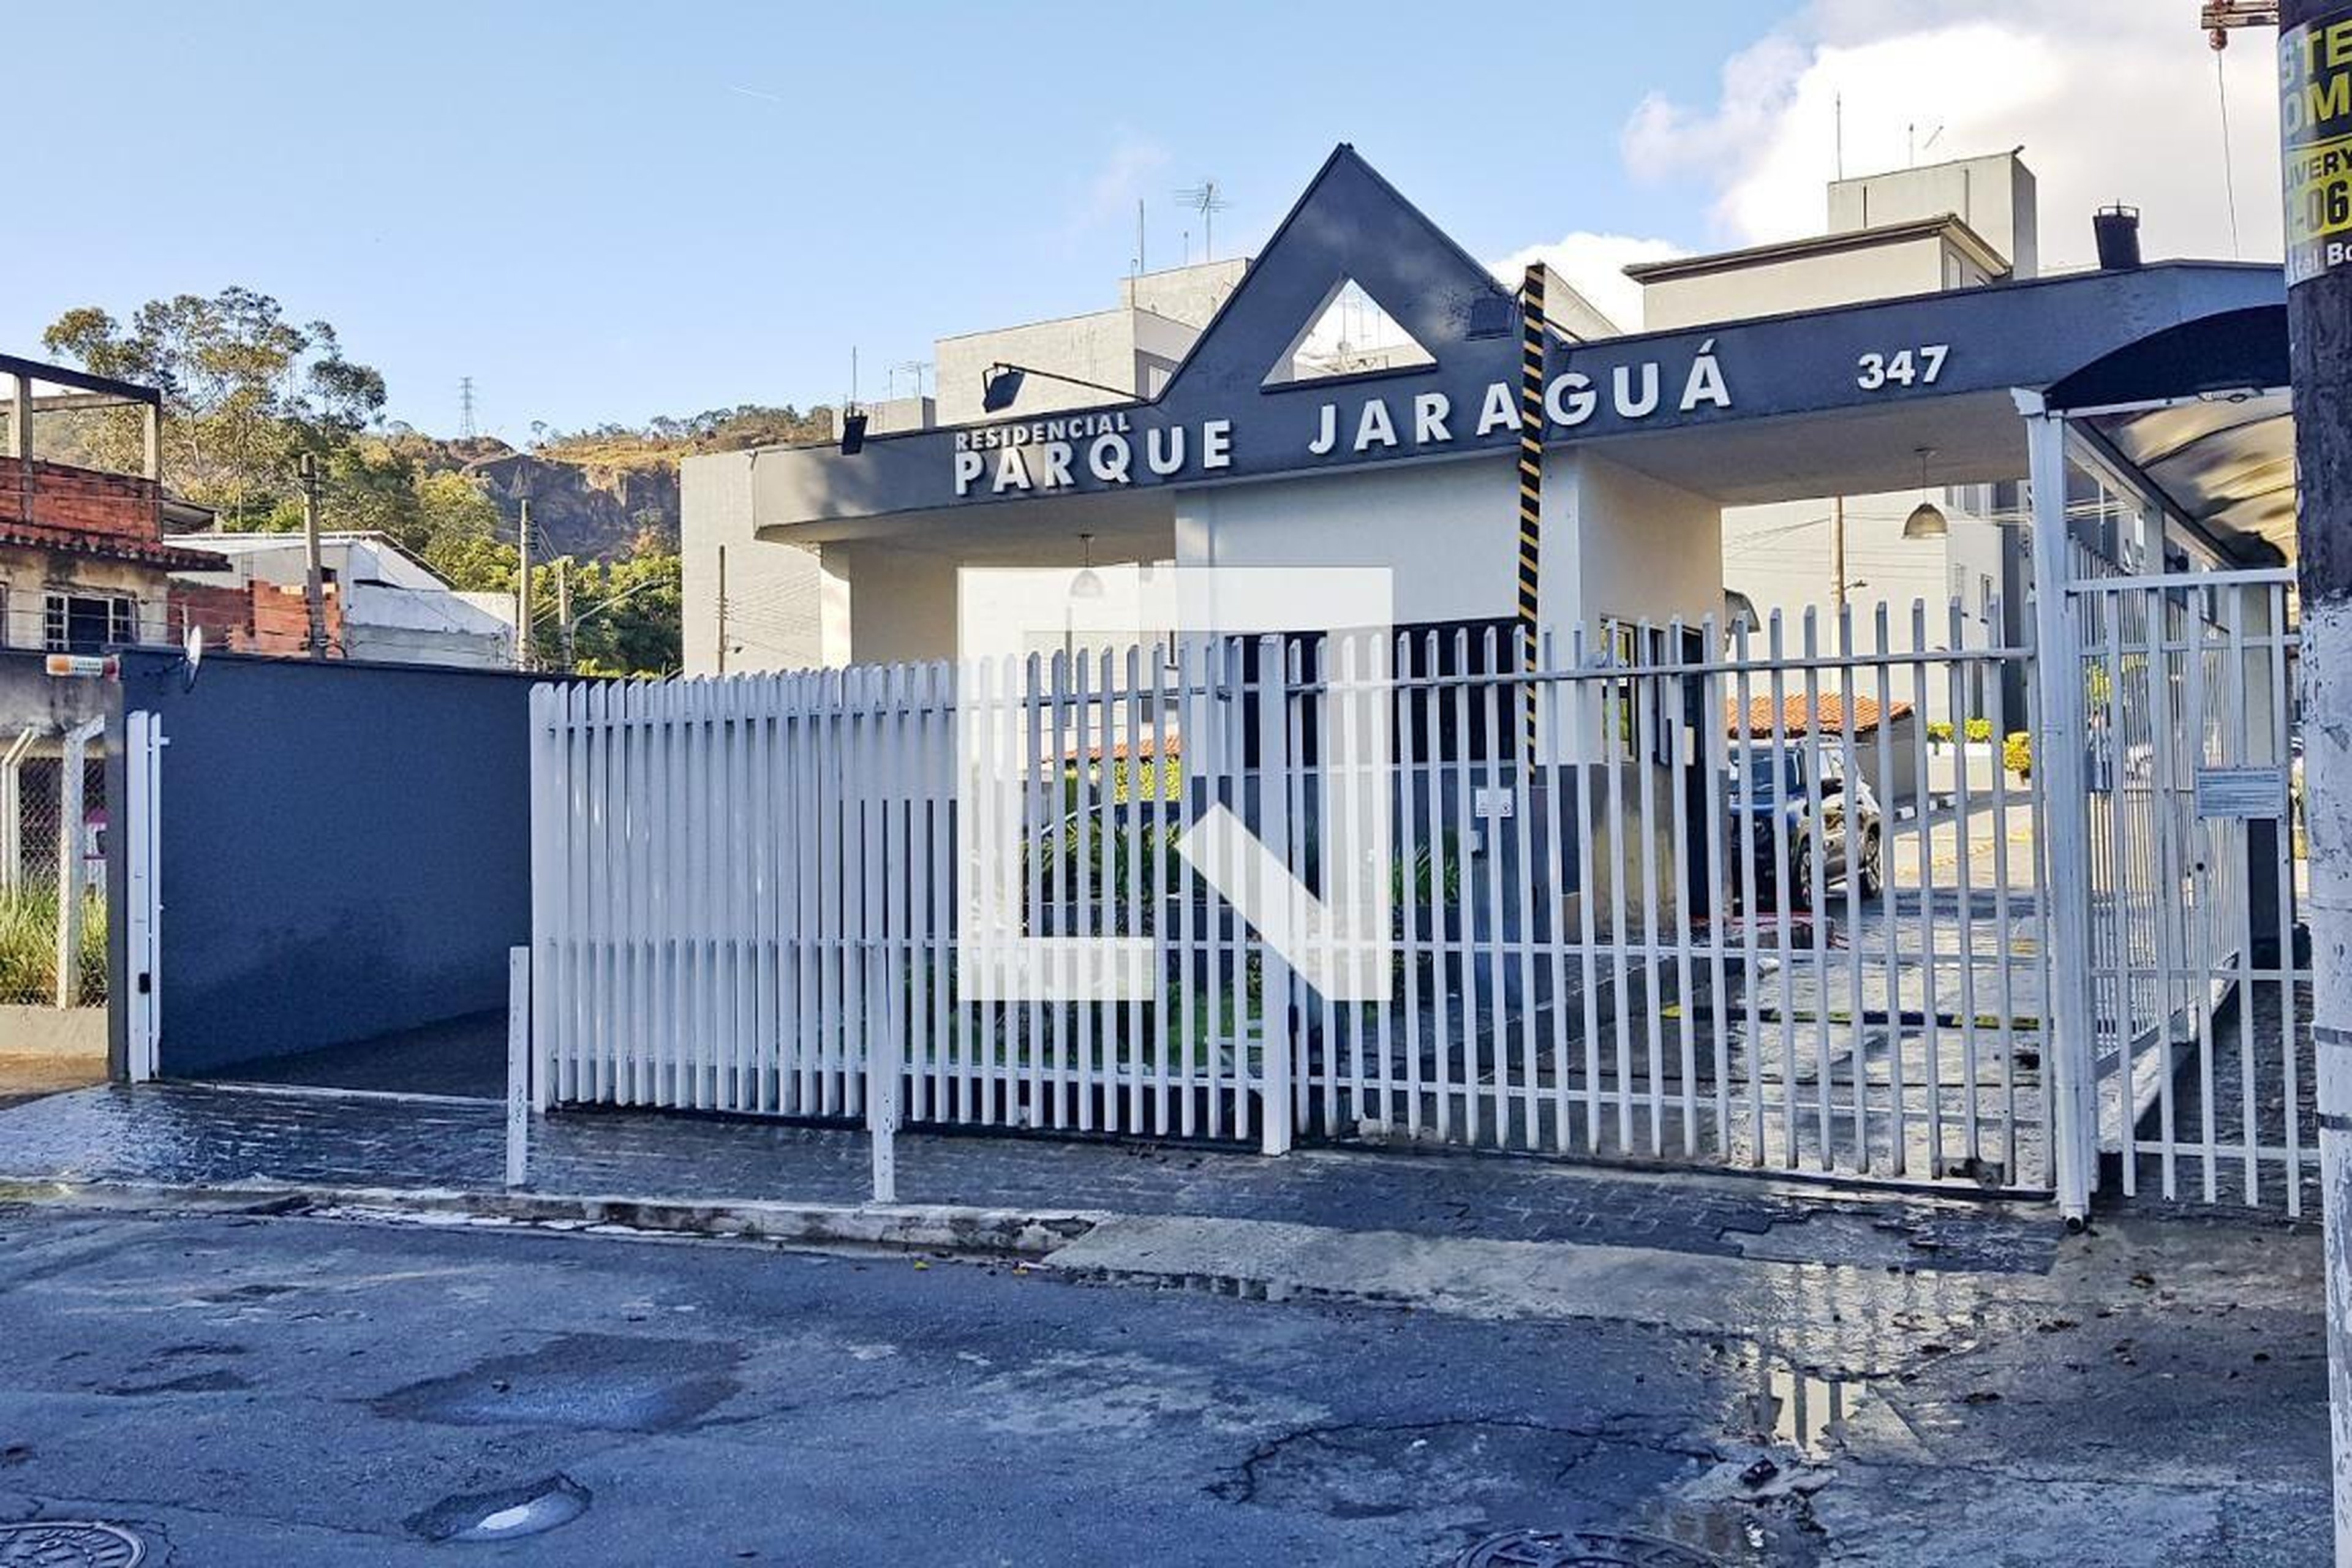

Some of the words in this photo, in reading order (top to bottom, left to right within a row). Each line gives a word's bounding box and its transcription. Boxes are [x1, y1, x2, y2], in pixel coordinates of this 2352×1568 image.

[1857, 345, 1948, 389] 347
[955, 420, 1230, 495] PARQUE
[1308, 338, 1731, 454] JARAGUÁ
[955, 413, 1131, 451] RESIDENCIAL
